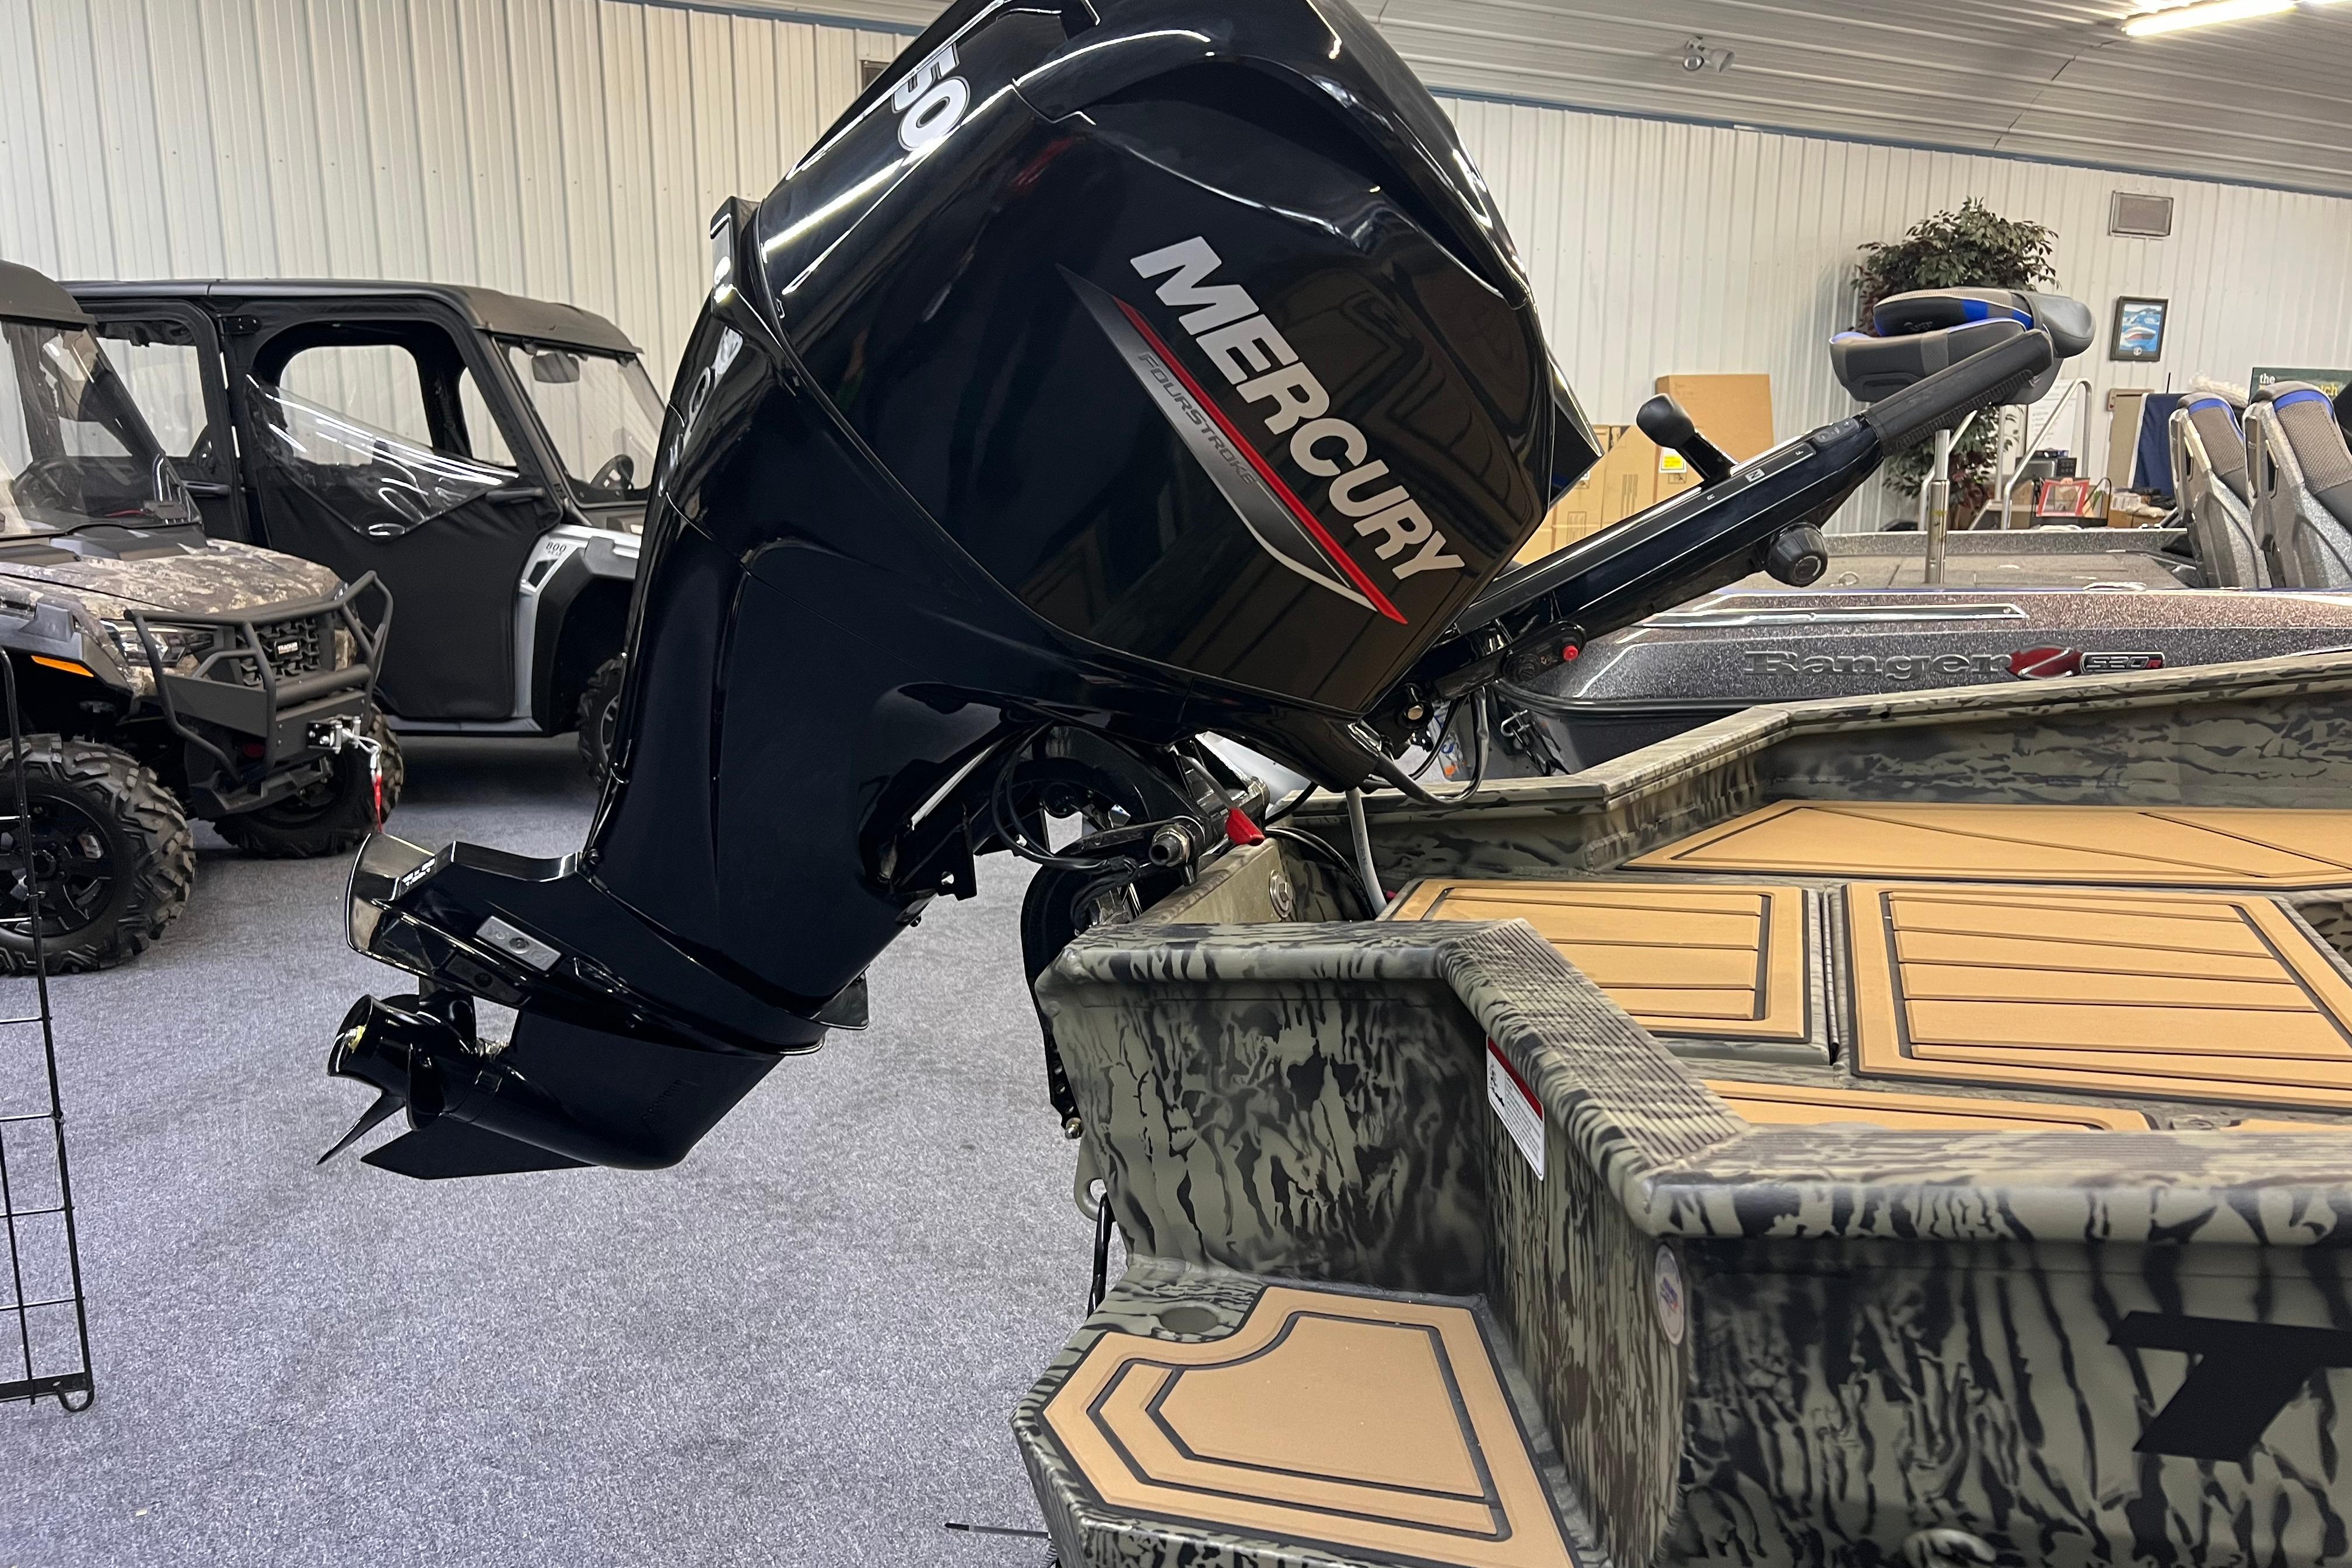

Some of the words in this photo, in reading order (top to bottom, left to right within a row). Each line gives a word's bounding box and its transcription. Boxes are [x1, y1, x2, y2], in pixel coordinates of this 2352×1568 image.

[1130, 236, 1465, 580] MERCURY
[1138, 352, 1256, 484] FOURSTROKE
[1743, 650, 2012, 680] Ranger
